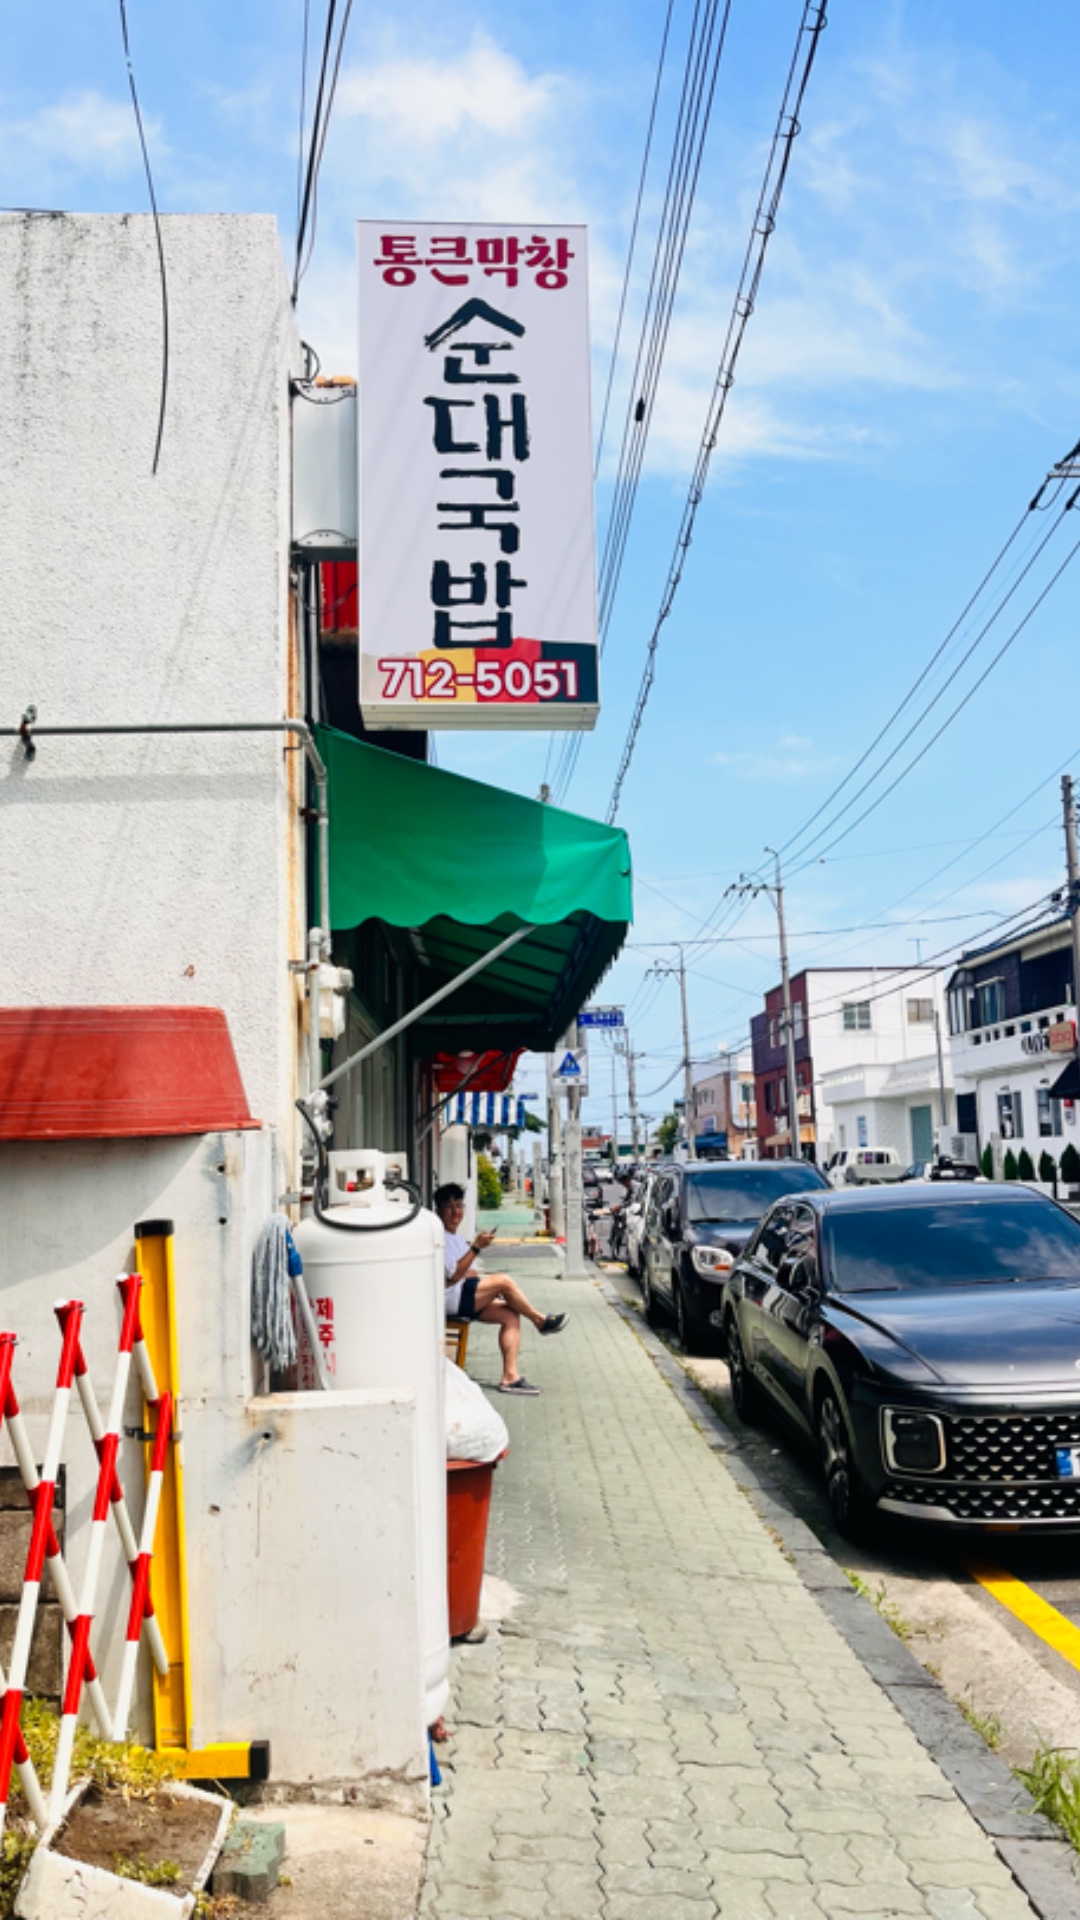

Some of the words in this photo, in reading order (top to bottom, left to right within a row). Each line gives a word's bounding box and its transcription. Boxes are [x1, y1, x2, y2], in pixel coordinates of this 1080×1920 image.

[374, 235, 574, 289] 통큰막창
[423, 297, 530, 649] 순대국밥
[378, 659, 579, 699] 712-5051
